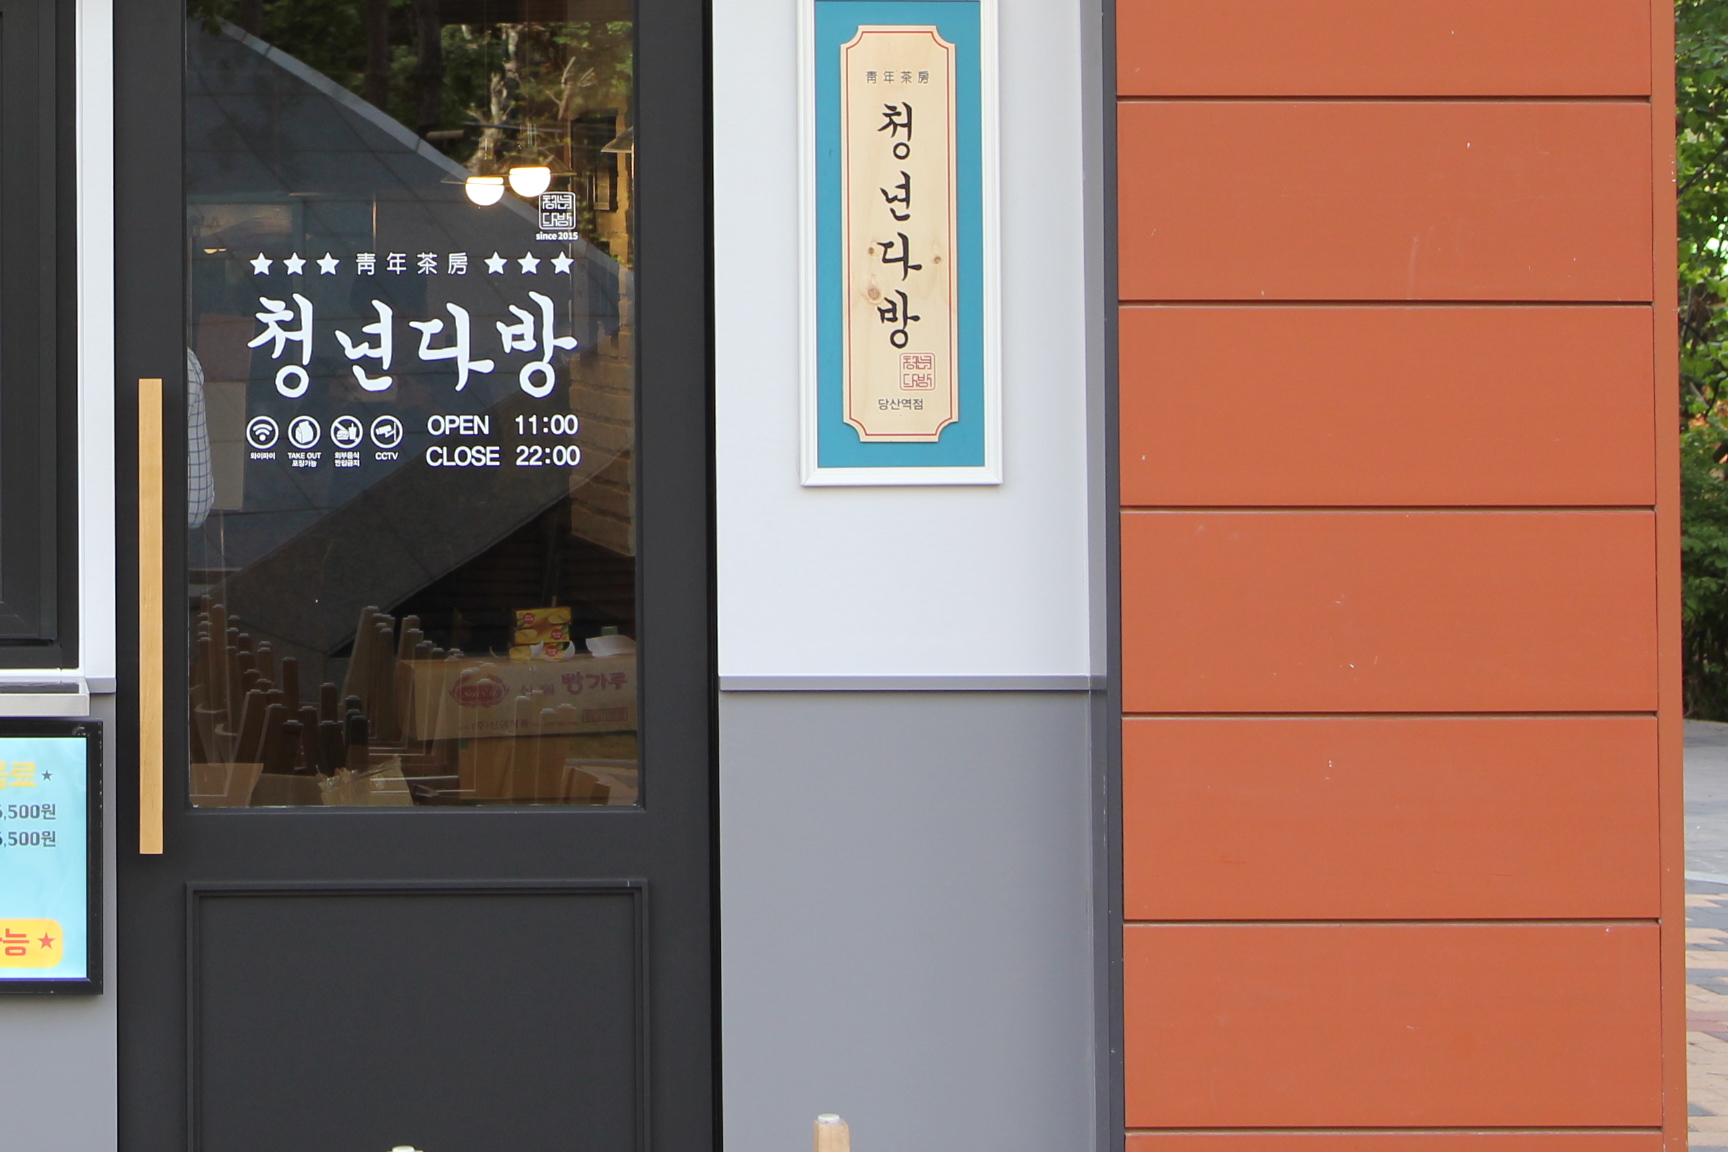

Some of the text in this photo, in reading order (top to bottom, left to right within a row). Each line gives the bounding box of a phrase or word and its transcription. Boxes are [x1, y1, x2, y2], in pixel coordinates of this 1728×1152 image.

[875, 100, 923, 350] 청년다방
[535, 231, 579, 241] since 2015
[247, 291, 578, 398] 청년다방
[878, 398, 923, 411] 당산역점
[427, 414, 578, 435] OPEN 11:00
[250, 451, 276, 460] 와이파이
[287, 451, 322, 460] TAKE OUT
[375, 451, 399, 461] CCTV
[426, 445, 581, 467] CLOSE 22:00
[291, 459, 317, 468] 포장가능
[560, 671, 628, 696] 빵가루
